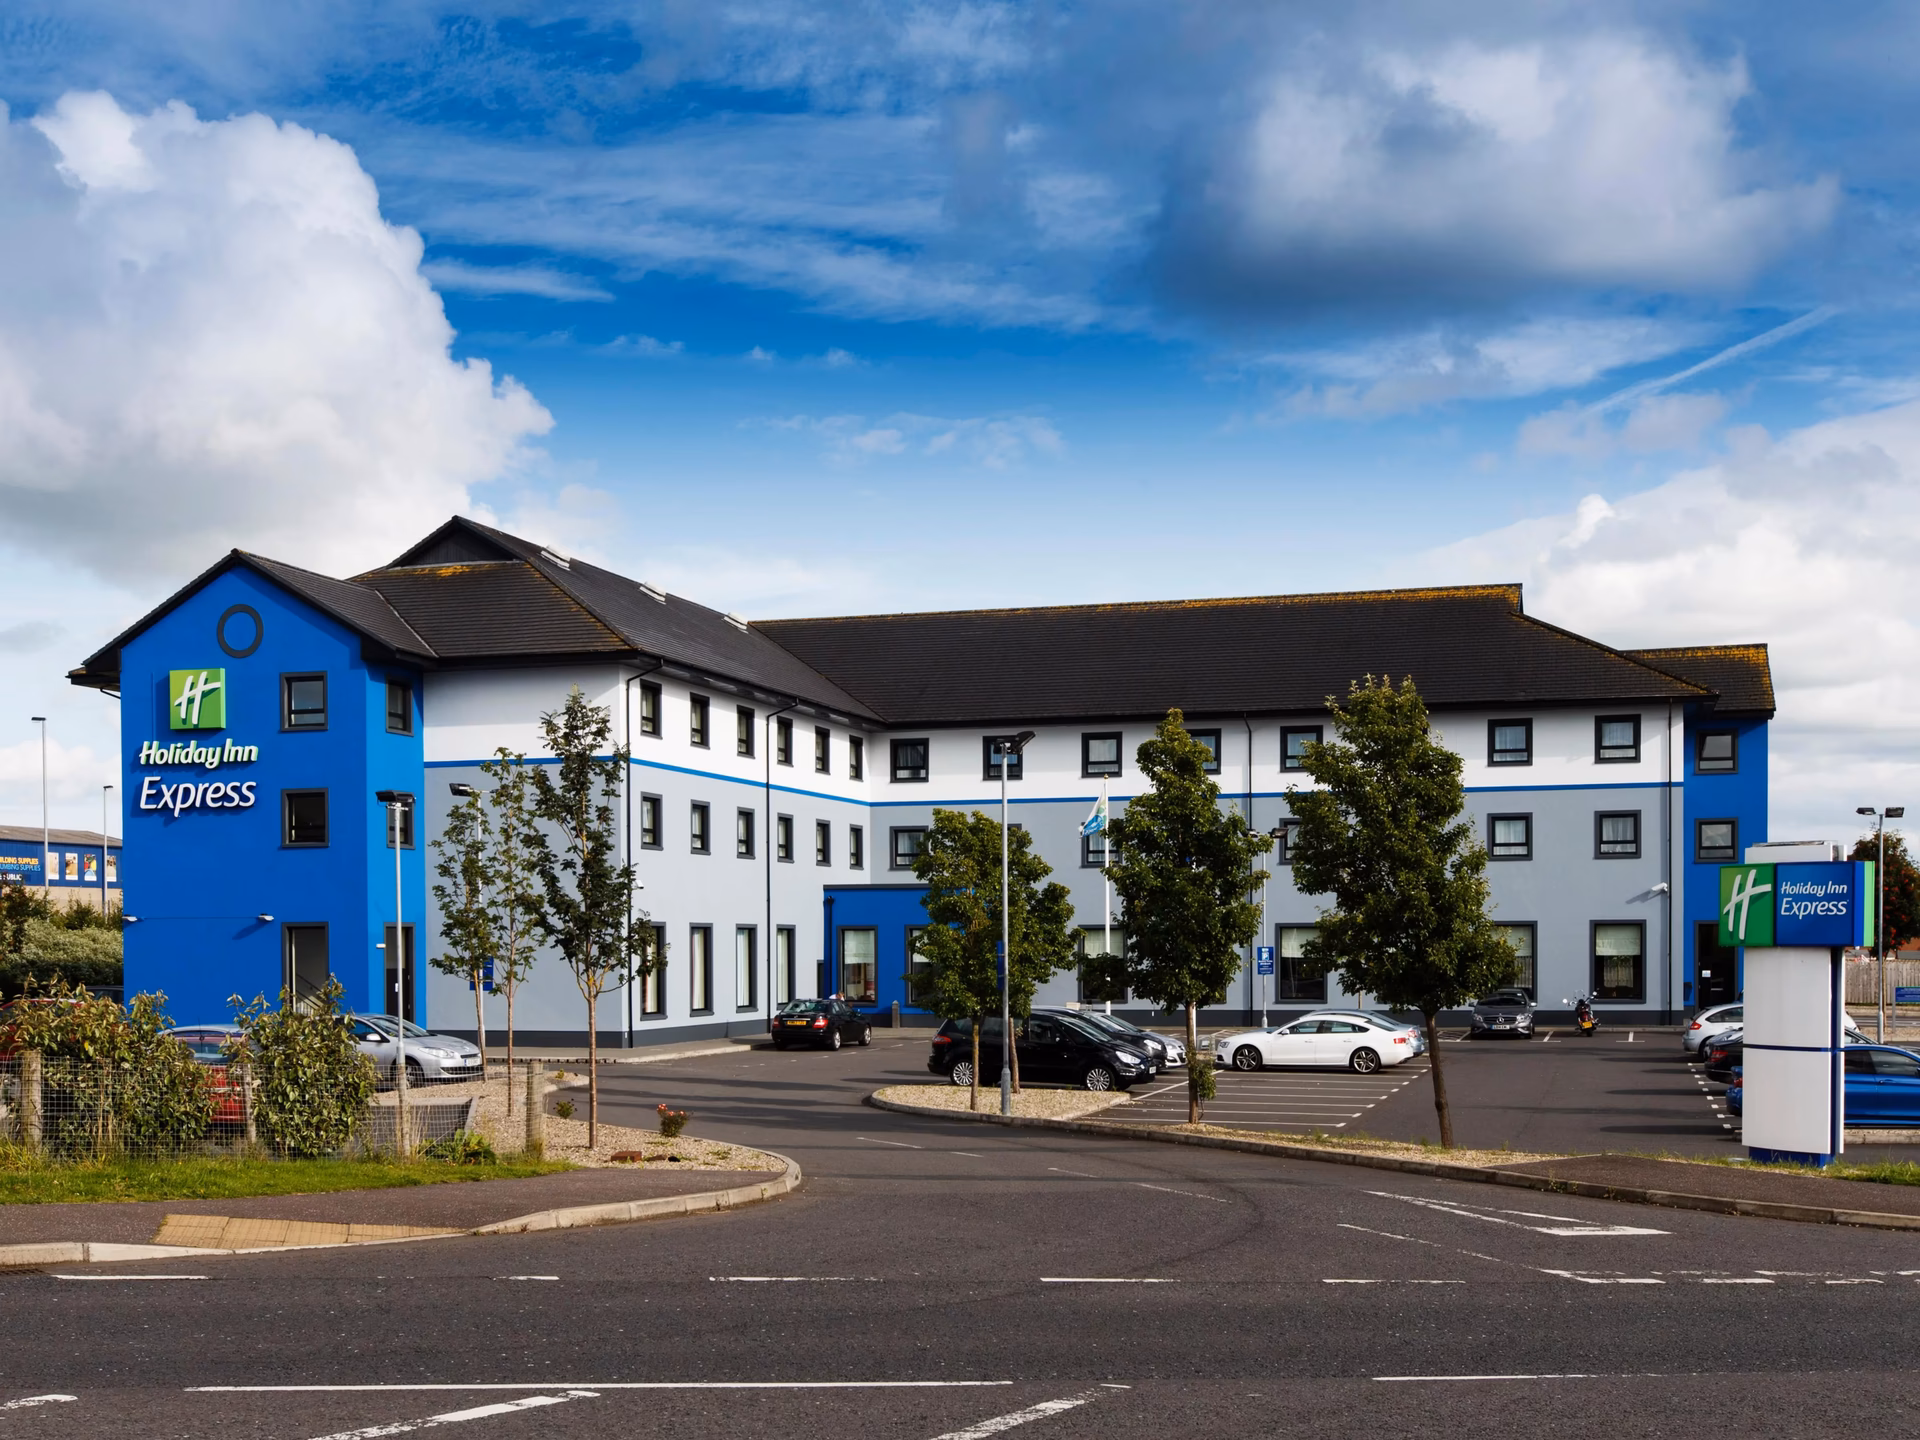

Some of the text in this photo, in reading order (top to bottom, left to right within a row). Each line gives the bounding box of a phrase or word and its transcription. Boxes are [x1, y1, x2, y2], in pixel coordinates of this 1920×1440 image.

[139, 738, 259, 769] Holiday Inn
[139, 776, 257, 818] Express
[1780, 880, 1848, 897] Holiday Inn
[1780, 898, 1848, 920] Express
